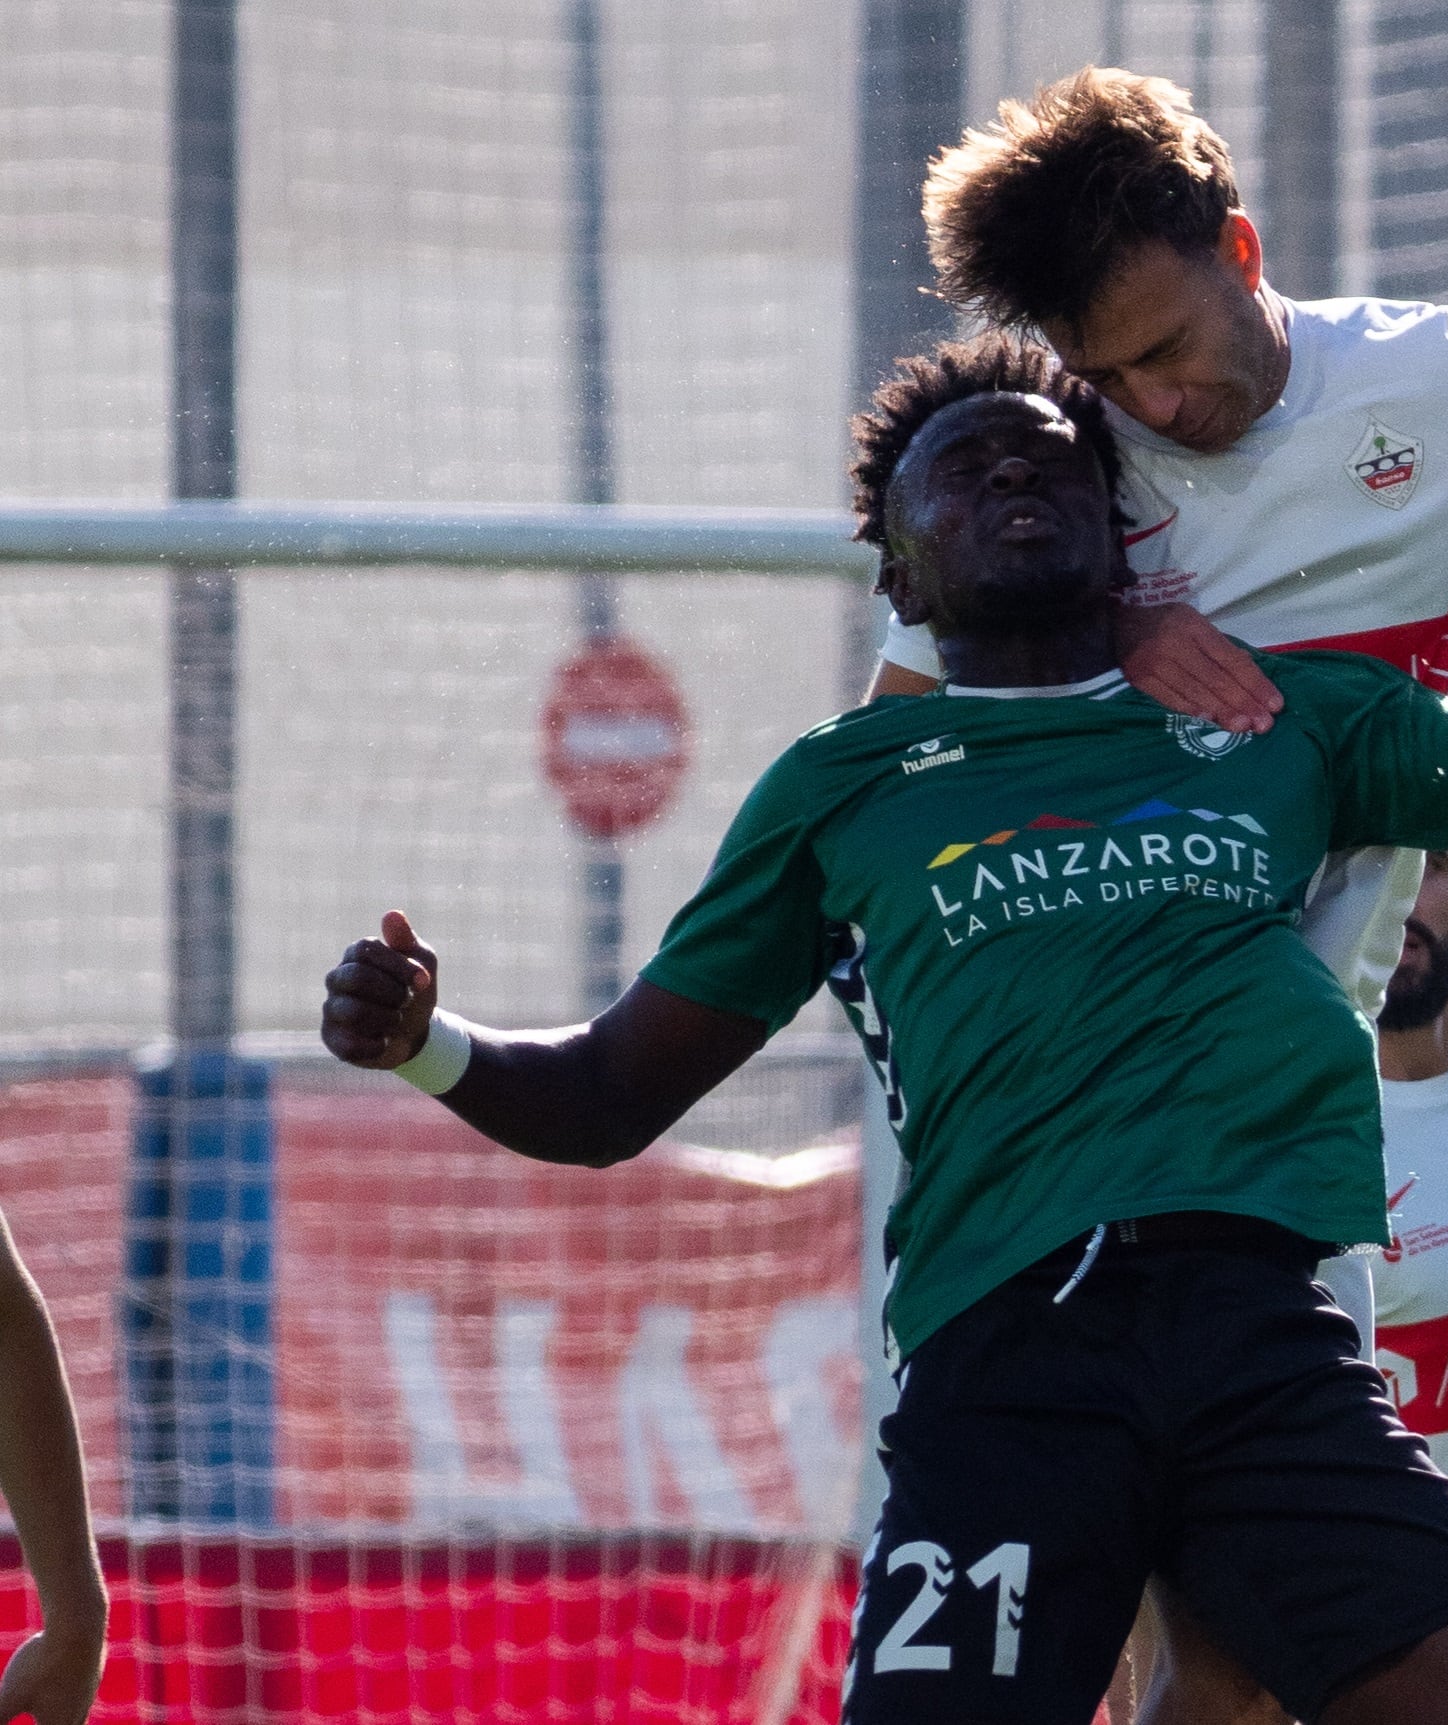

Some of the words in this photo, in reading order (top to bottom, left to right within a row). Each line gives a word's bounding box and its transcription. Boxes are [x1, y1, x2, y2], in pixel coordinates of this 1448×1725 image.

[902, 744, 966, 775] hummel
[931, 833, 1271, 917] LANZAROTE
[944, 914, 987, 947] LA
[1002, 887, 1084, 922] ISLA
[874, 1539, 1031, 1676] 21
